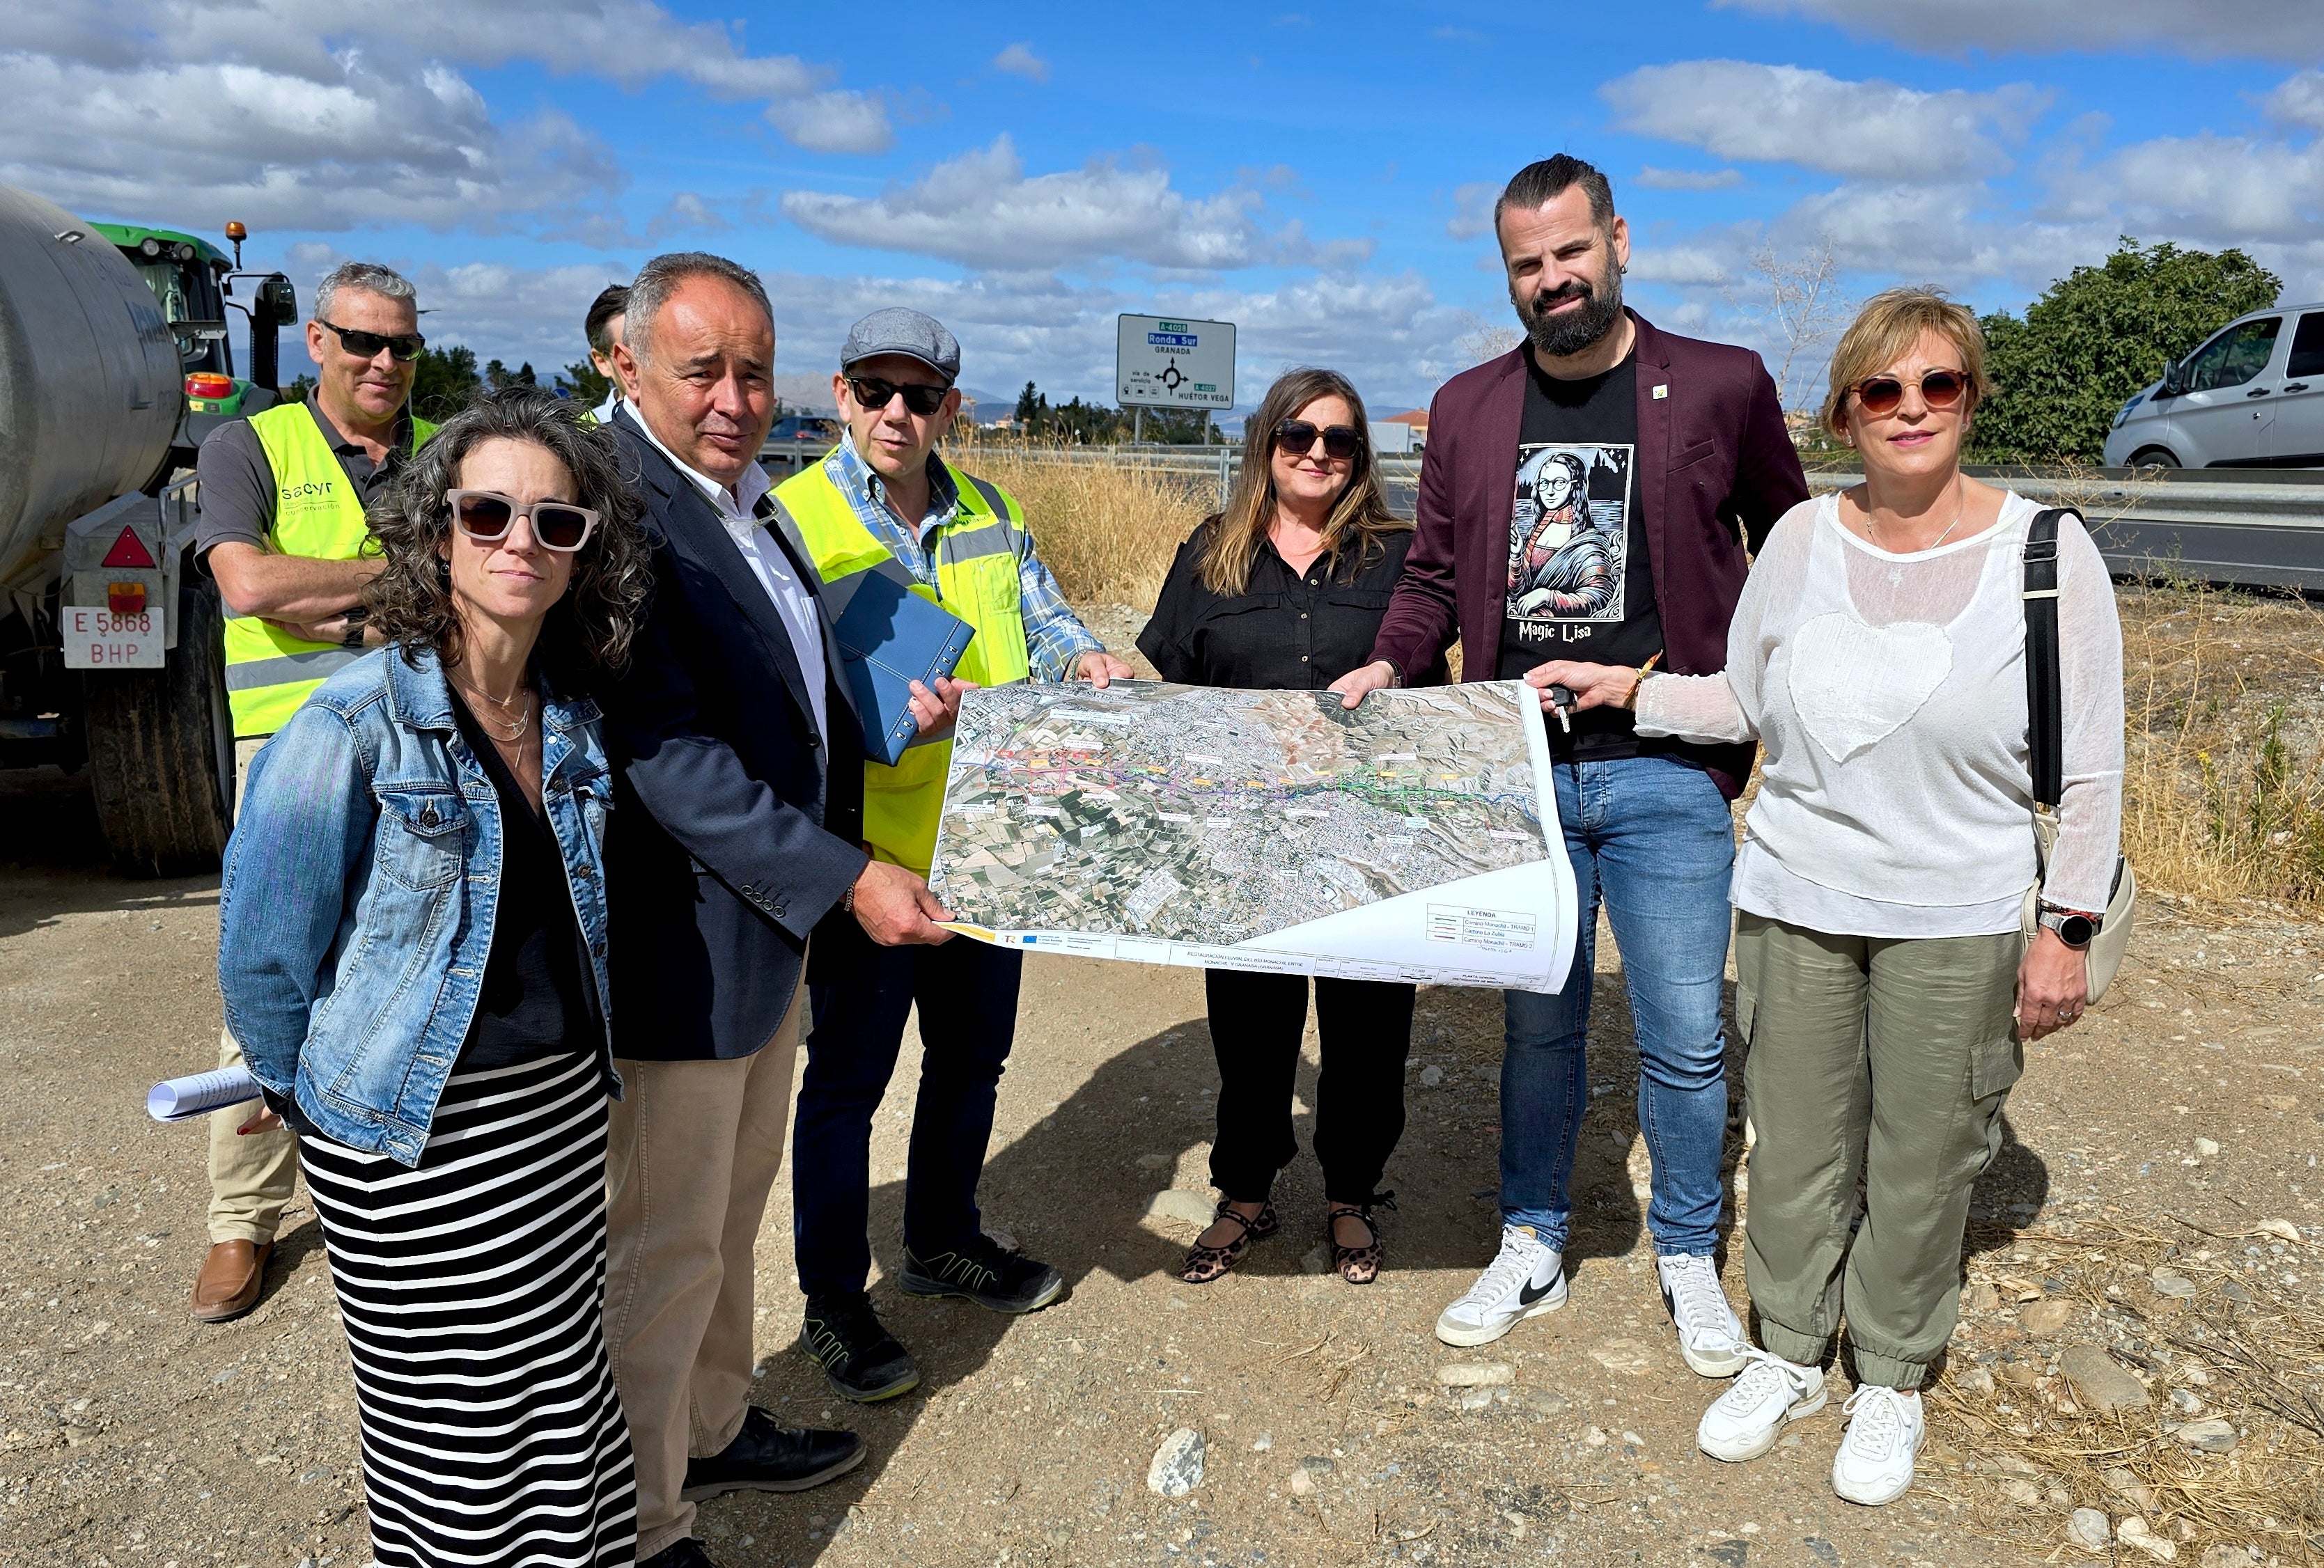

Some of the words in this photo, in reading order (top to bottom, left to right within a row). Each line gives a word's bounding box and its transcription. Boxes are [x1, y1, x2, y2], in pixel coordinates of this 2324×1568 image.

[1160, 322, 1187, 332] A-4028
[1149, 334, 1176, 344] Ronda
[1181, 336, 1196, 345] Sur
[1155, 347, 1191, 355] GRANADA
[1178, 391, 1208, 400] HUÉTOR
[1211, 394, 1229, 402] VEGA
[281, 483, 332, 500] sacyr
[286, 503, 341, 516] conservación
[75, 613, 88, 632] E
[96, 613, 151, 633] 5868
[1519, 621, 1555, 642] Magic
[1562, 624, 1591, 643] Lisa
[91, 643, 139, 664] BHP
